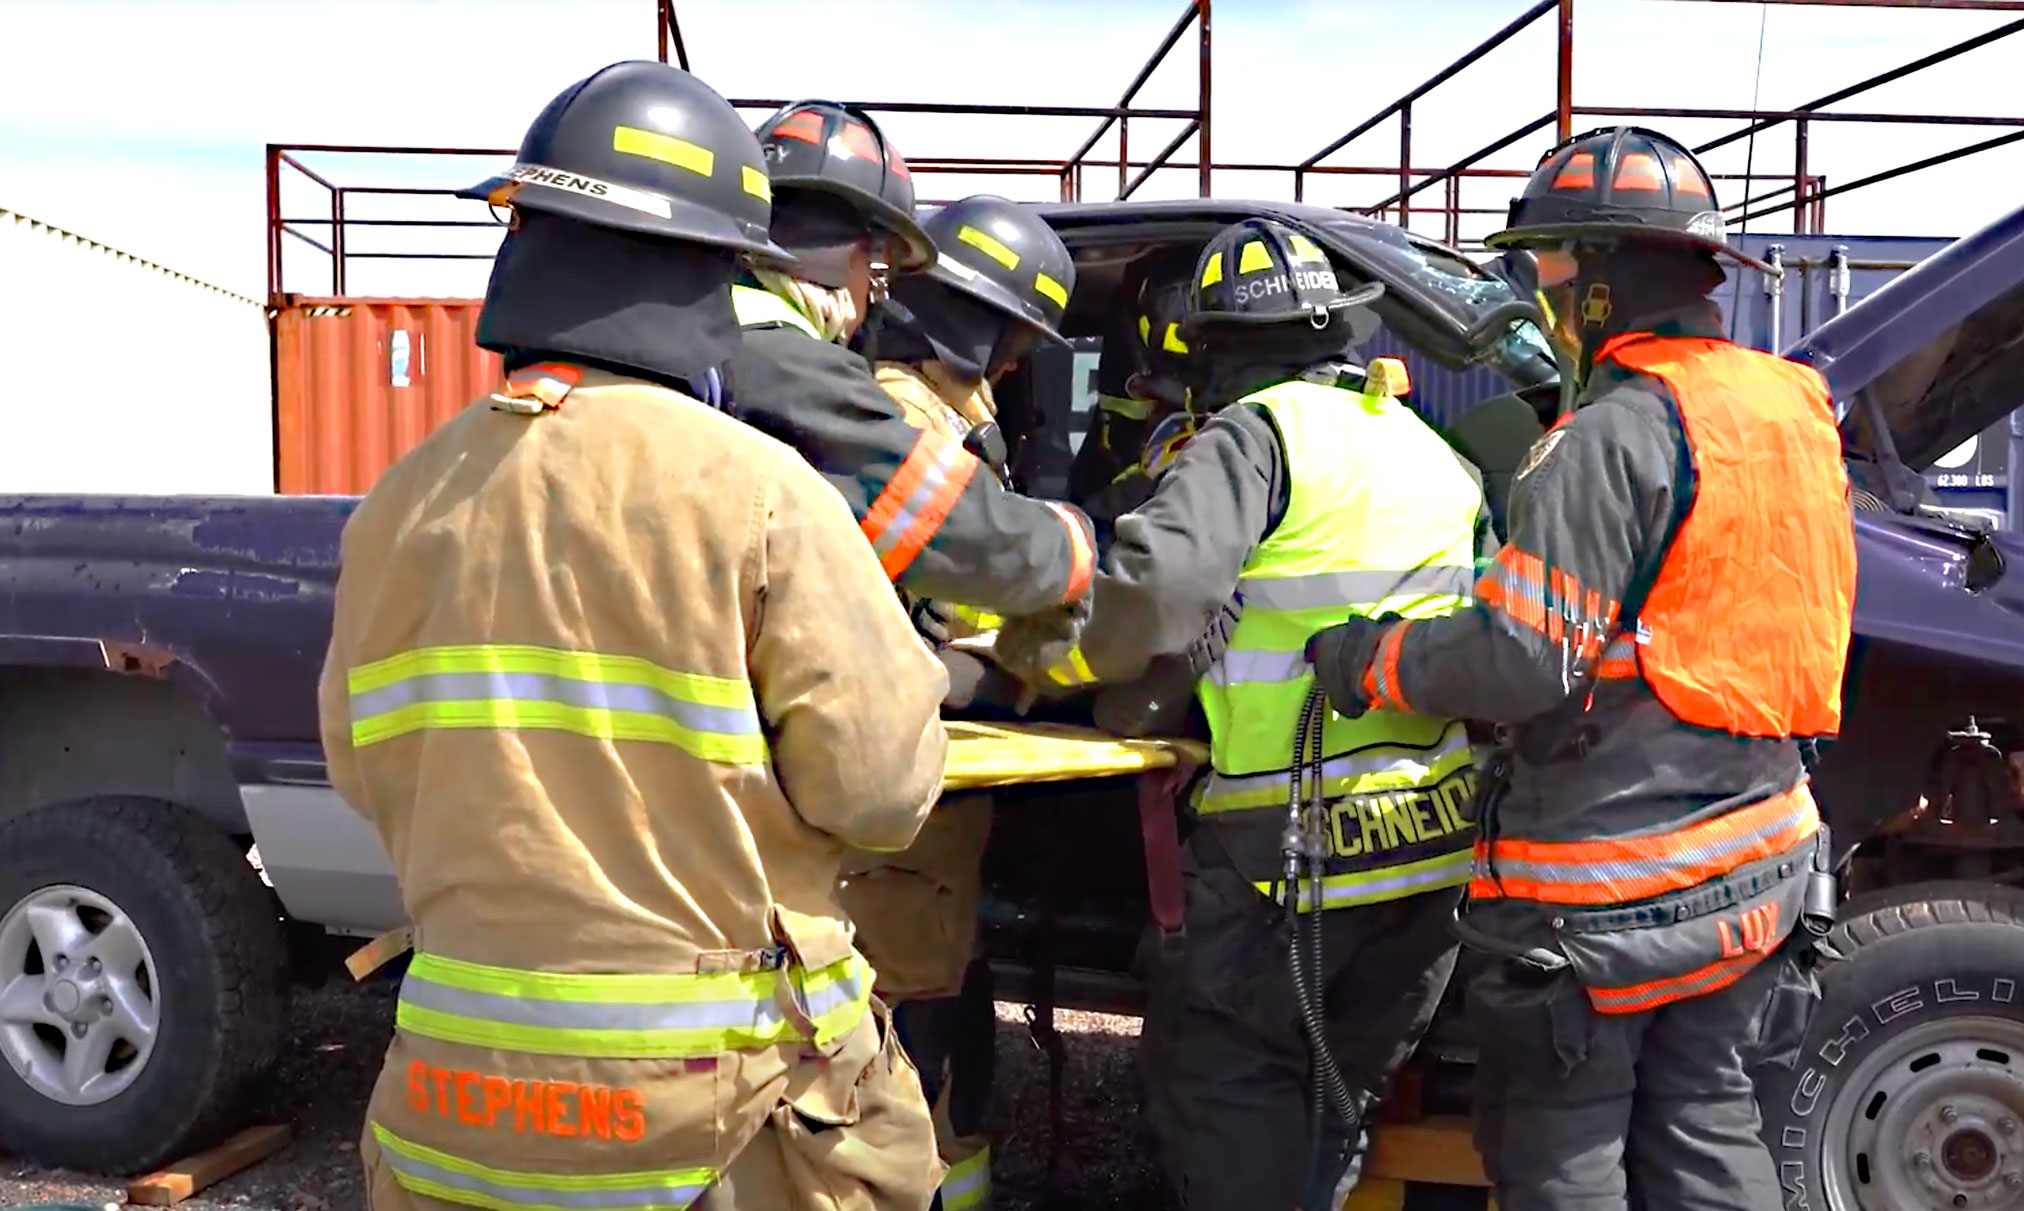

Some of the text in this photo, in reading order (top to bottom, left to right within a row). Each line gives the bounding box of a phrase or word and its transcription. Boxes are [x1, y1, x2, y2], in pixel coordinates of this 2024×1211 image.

[1975, 474, 1994, 487] LBS
[1718, 902, 1778, 957] LUX
[406, 1059, 645, 1141] STEPHENS
